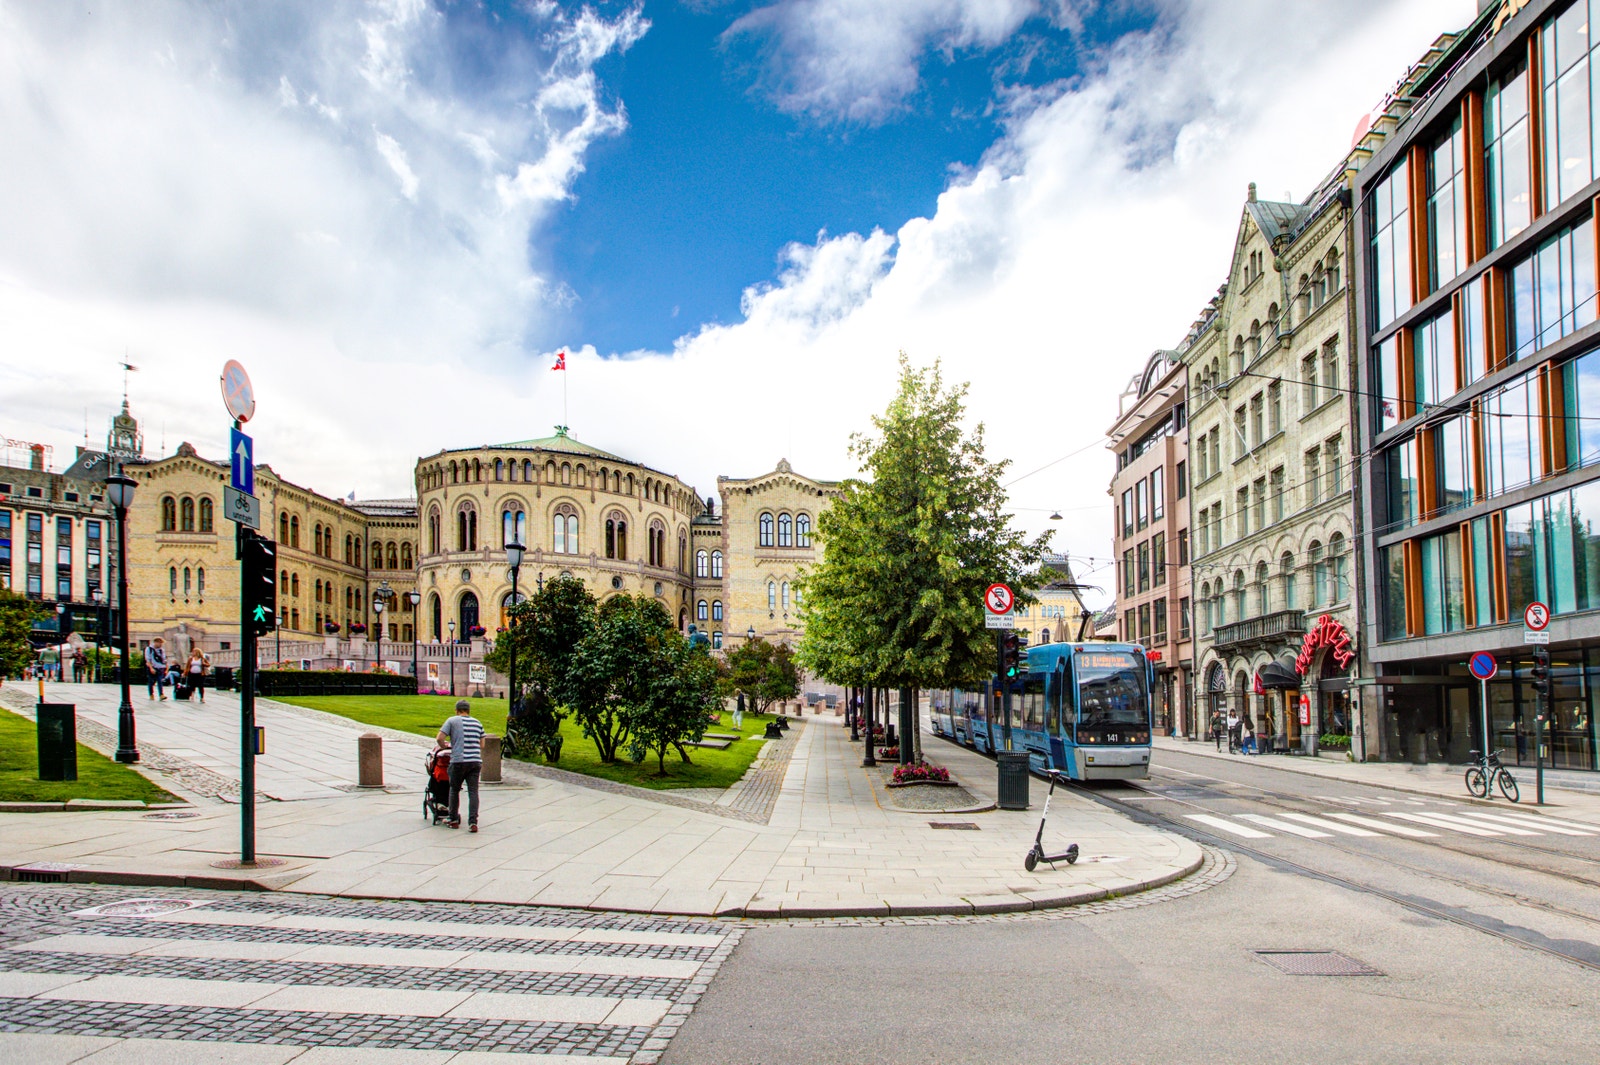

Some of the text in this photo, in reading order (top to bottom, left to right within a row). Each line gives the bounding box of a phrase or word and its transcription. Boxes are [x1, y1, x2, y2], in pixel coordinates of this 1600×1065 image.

[83, 453, 105, 469] OLAV
[1318, 614, 1355, 670] PIZZA
[1081, 655, 1090, 667] 13
[1107, 734, 1118, 742] 141
